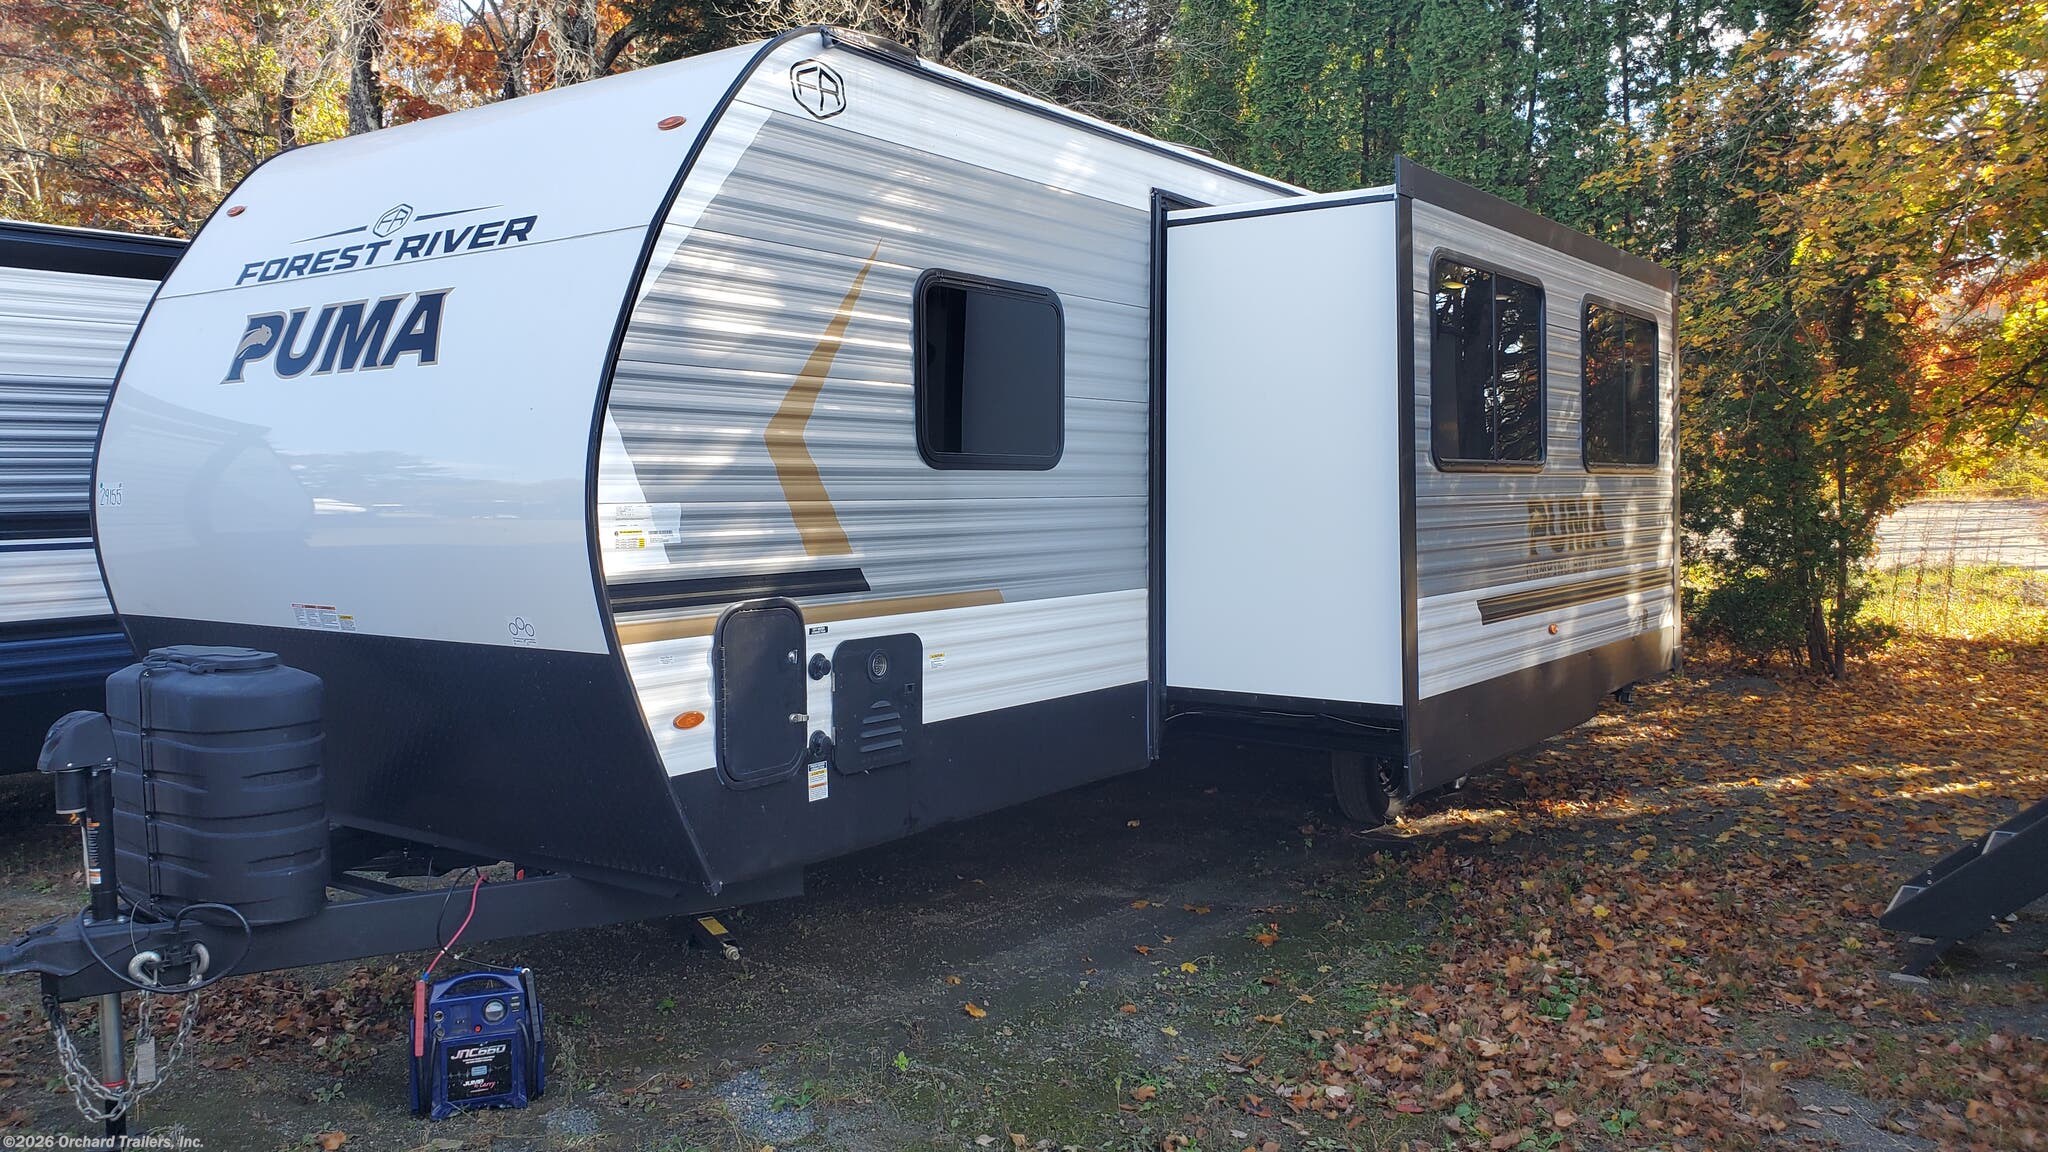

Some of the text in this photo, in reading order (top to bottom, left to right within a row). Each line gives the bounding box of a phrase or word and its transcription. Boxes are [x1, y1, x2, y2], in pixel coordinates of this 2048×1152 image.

[235, 214, 538, 286] FOREST RIVER
[220, 287, 456, 385] PUMA
[1527, 495, 1609, 556] PUMA
[451, 1044, 506, 1060] JNC660
